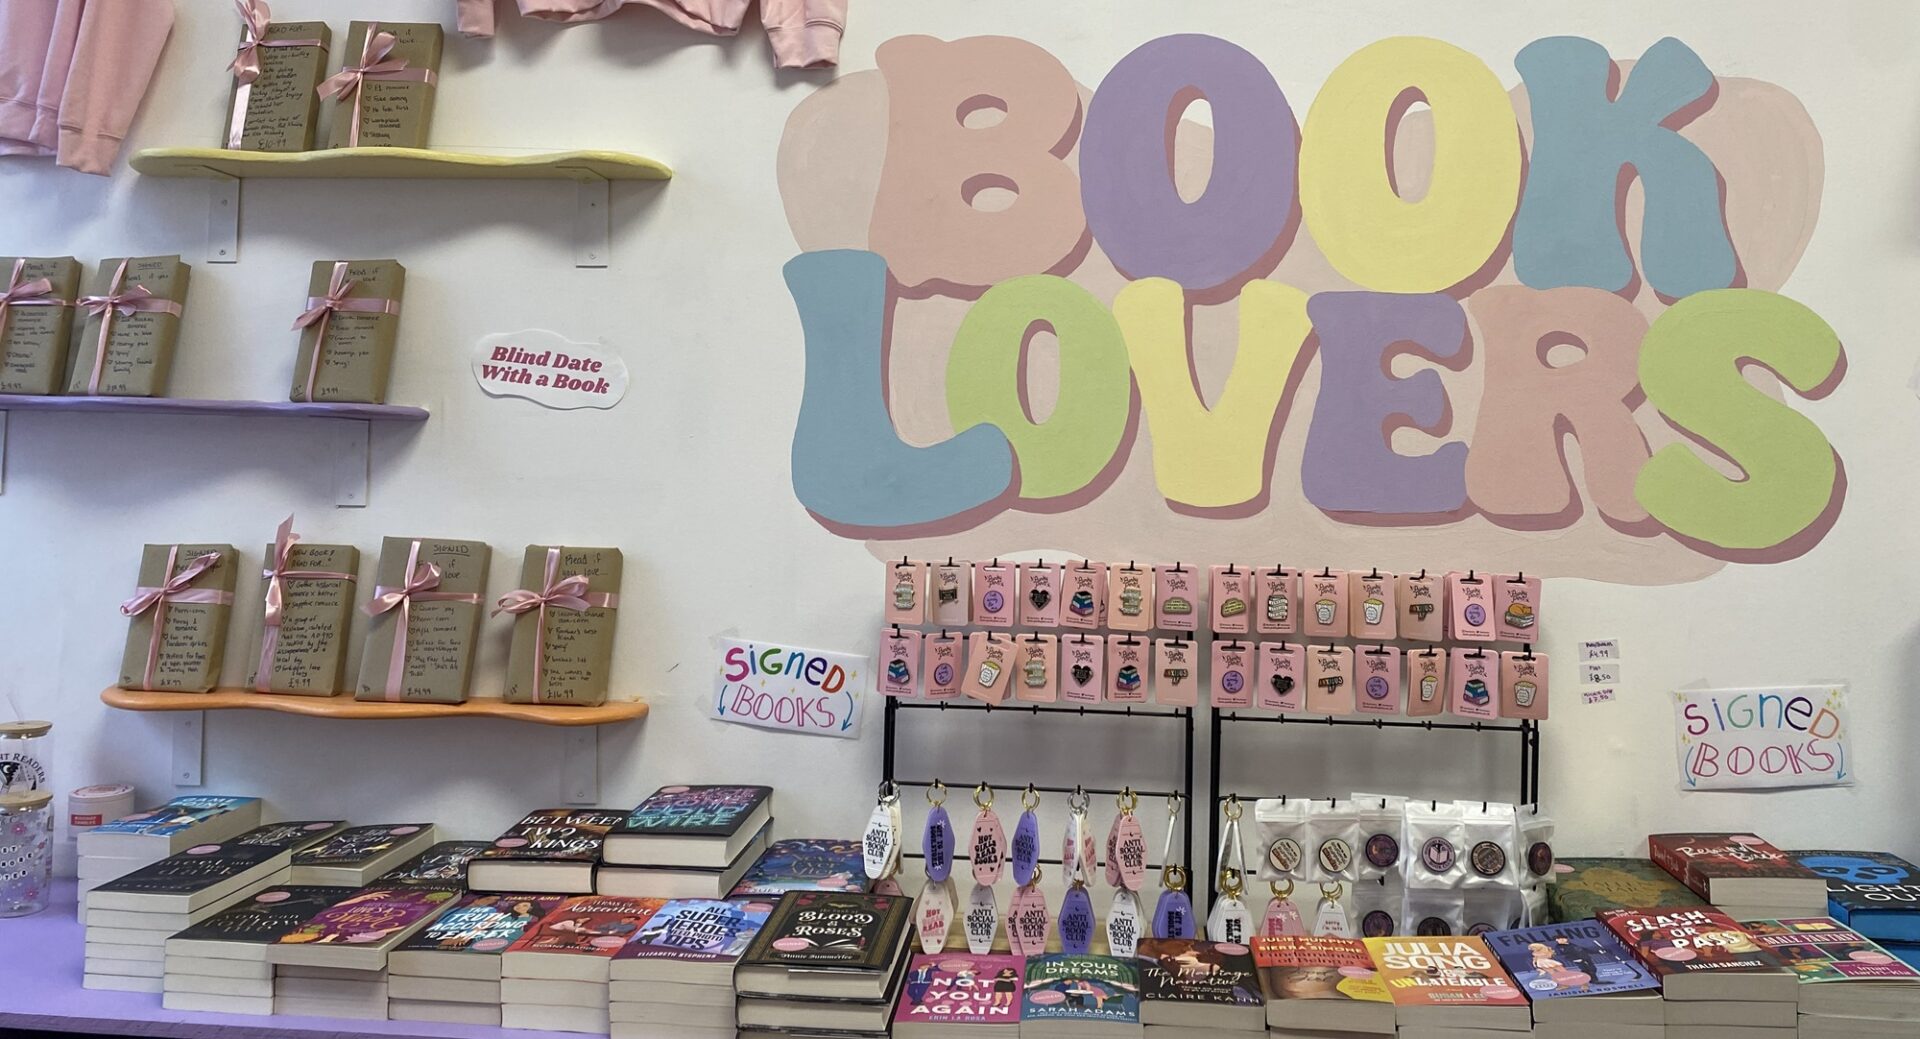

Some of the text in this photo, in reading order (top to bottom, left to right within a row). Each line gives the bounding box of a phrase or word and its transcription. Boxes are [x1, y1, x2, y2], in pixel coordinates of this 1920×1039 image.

[868, 33, 1746, 300] BOOK
[490, 346, 602, 373] Blind Date
[482, 364, 610, 394] With a Book
[782, 249, 1847, 564] LOVERS
[731, 684, 835, 727] BOOKS
[1692, 739, 1835, 777] BOOKS
[521, 827, 576, 836] TWO
[871, 829, 888, 838] ANTI
[530, 838, 601, 850] KINGS
[866, 835, 890, 846] SOCIAL
[978, 834, 992, 844] HOT
[1124, 840, 1141, 848] ANTI
[867, 842, 886, 852] BOOK
[974, 840, 997, 852] GIRLS
[1120, 846, 1145, 854] SOCIAL
[868, 849, 884, 858] CLUB
[975, 848, 997, 858] READ
[974, 856, 998, 866] BOOKS
[705, 906, 727, 914] ALL
[926, 908, 940, 916] HOT
[449, 912, 512, 922] TRUTH
[1066, 914, 1086, 922] ANTI
[1113, 918, 1132, 926] ANTI
[1626, 910, 1706, 932] SLASH
[426, 922, 528, 931] ACCORDING
[662, 918, 737, 938] HEROES
[922, 923, 944, 932] READ
[970, 922, 992, 930] BOOK
[1062, 920, 1091, 928] SOCIAL
[972, 928, 991, 936] CLUB
[1024, 930, 1044, 938] CLUB
[1109, 925, 1136, 934] SOCIAL
[1670, 926, 1698, 938] OR
[436, 930, 516, 940] EMBER
[690, 932, 724, 942] PHOTO
[1066, 934, 1086, 942] CLUB
[1112, 932, 1132, 940] BOOK
[1497, 926, 1600, 947] FALLING
[663, 935, 710, 950] OPS
[1113, 938, 1132, 947] CLUB
[1299, 937, 1354, 945] MURPHY
[1672, 932, 1741, 949] PASS
[1382, 942, 1481, 956] JULIA
[1070, 961, 1118, 970] YOUR
[1383, 956, 1491, 970] SONG
[1686, 960, 1764, 971] THALIA SANCHEZ
[1046, 968, 1119, 976] DREAMS
[933, 978, 994, 988] NOT
[1160, 977, 1238, 988] Narrative
[930, 991, 992, 1000] YOU
[1549, 984, 1645, 998] JANISHA BOSWELL
[1214, 994, 1260, 1003] KANN
[910, 1004, 1009, 1014] AGAIN
[1084, 1008, 1136, 1017] ADAMS
